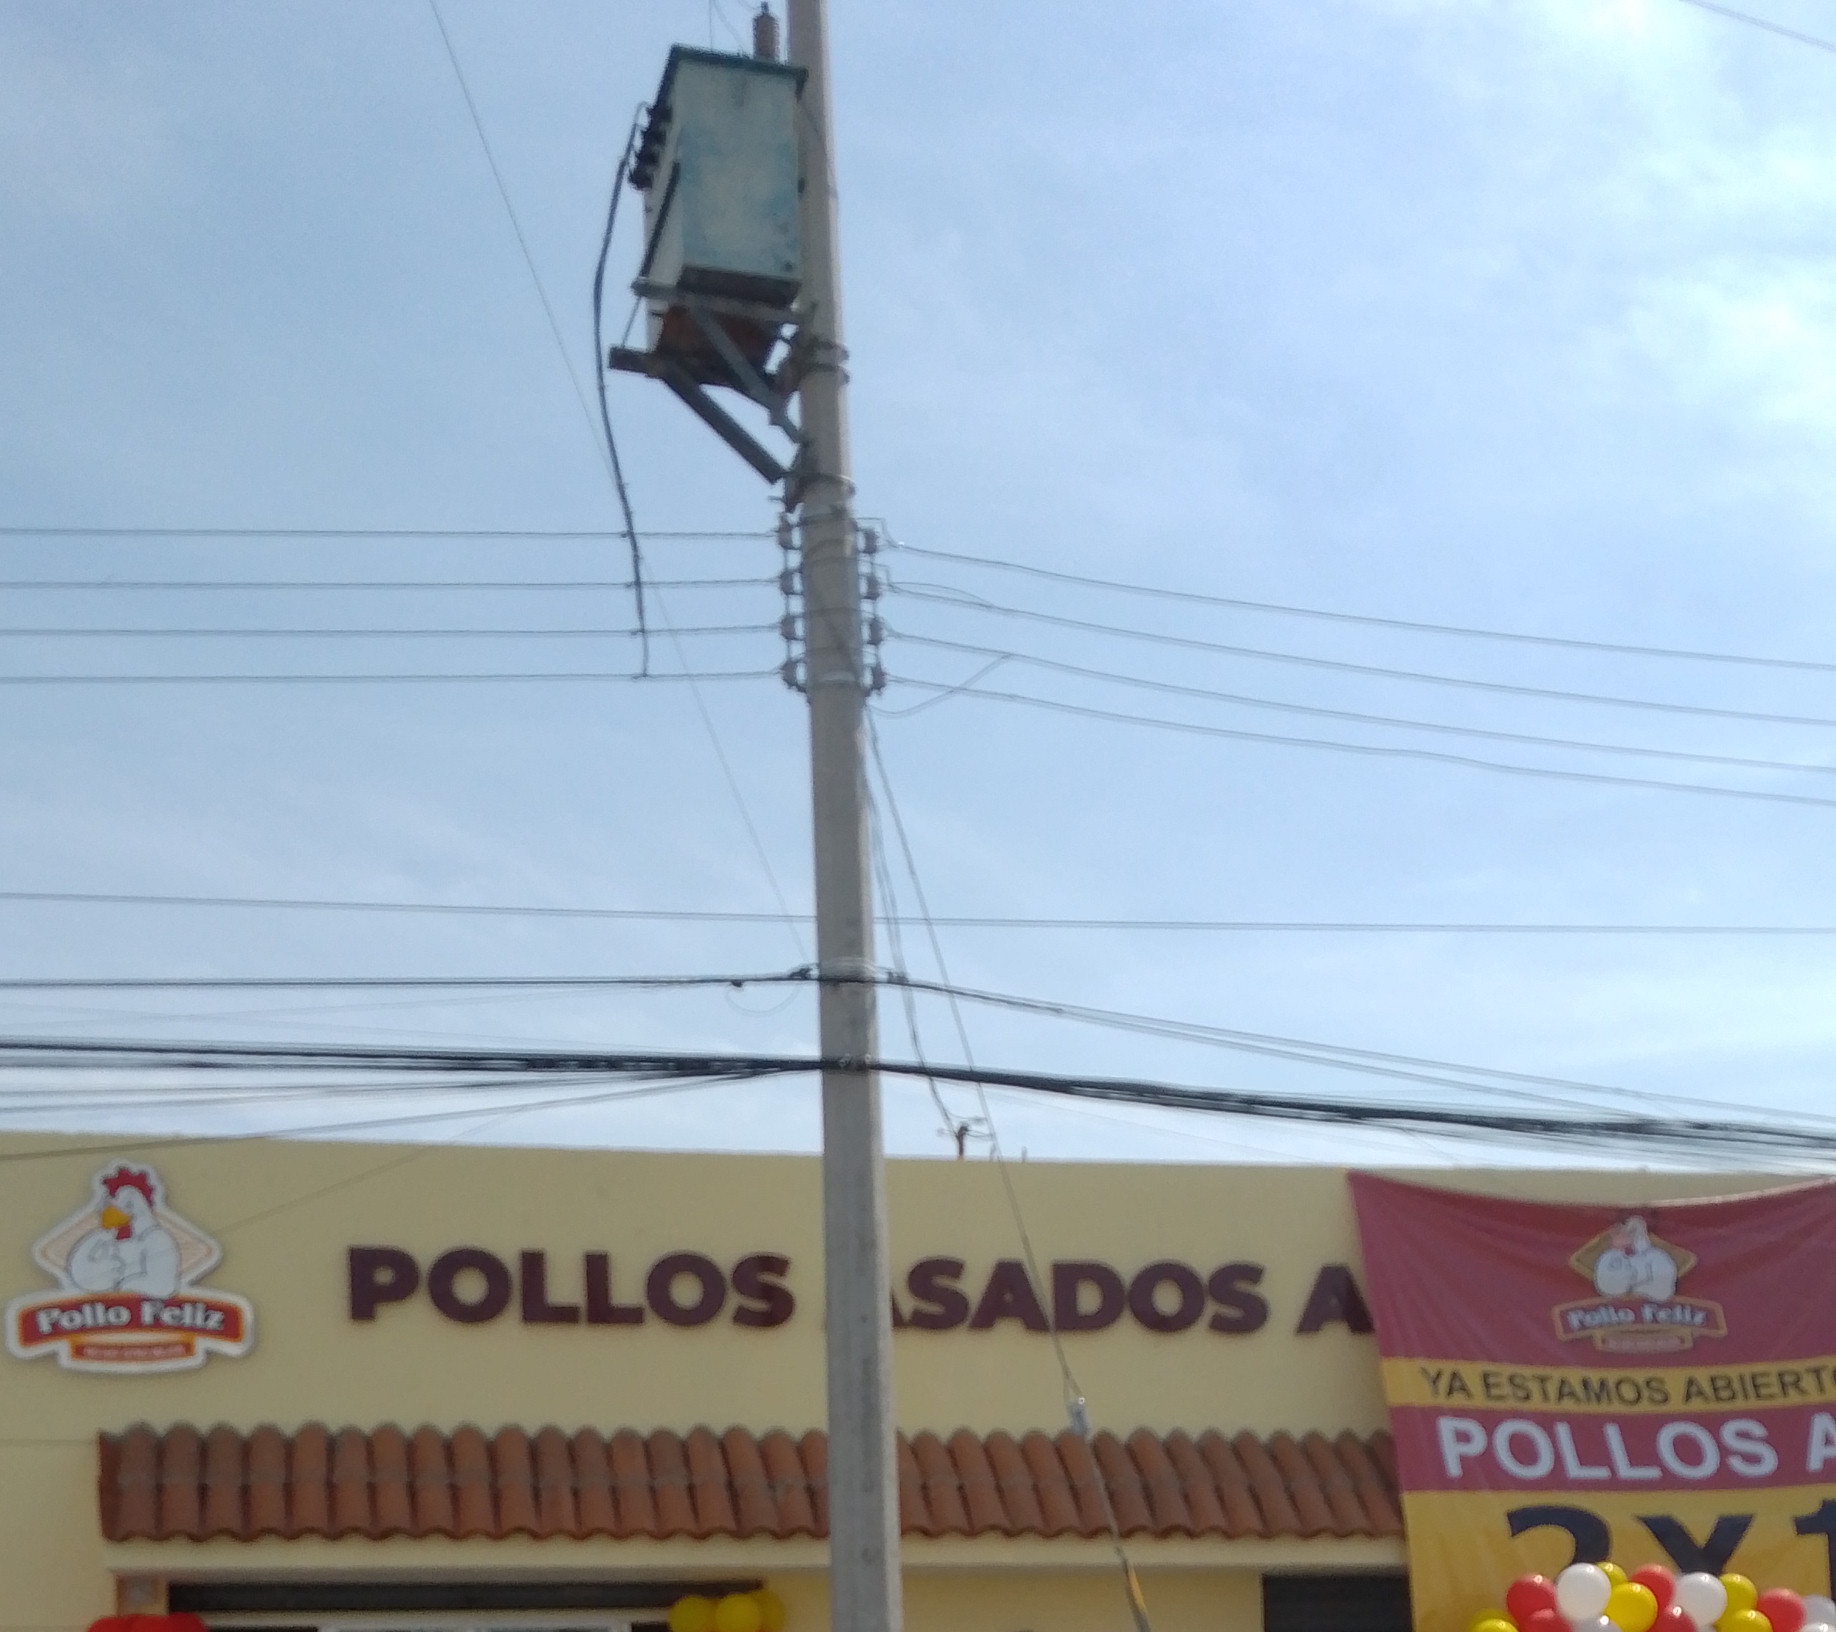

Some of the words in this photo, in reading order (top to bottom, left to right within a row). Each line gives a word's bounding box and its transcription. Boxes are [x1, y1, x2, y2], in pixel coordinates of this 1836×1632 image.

[348, 1246, 796, 1328] POLLOS
[891, 1255, 1269, 1334] SADOS
[36, 1303, 131, 1335] Pollo
[140, 1300, 225, 1331] Feliz
[1420, 1366, 1474, 1399] YA
[1481, 1369, 1670, 1406] ESTAMOS
[1683, 1365, 1836, 1404] ABIERT
[1436, 1415, 1779, 1480] POLLOS
